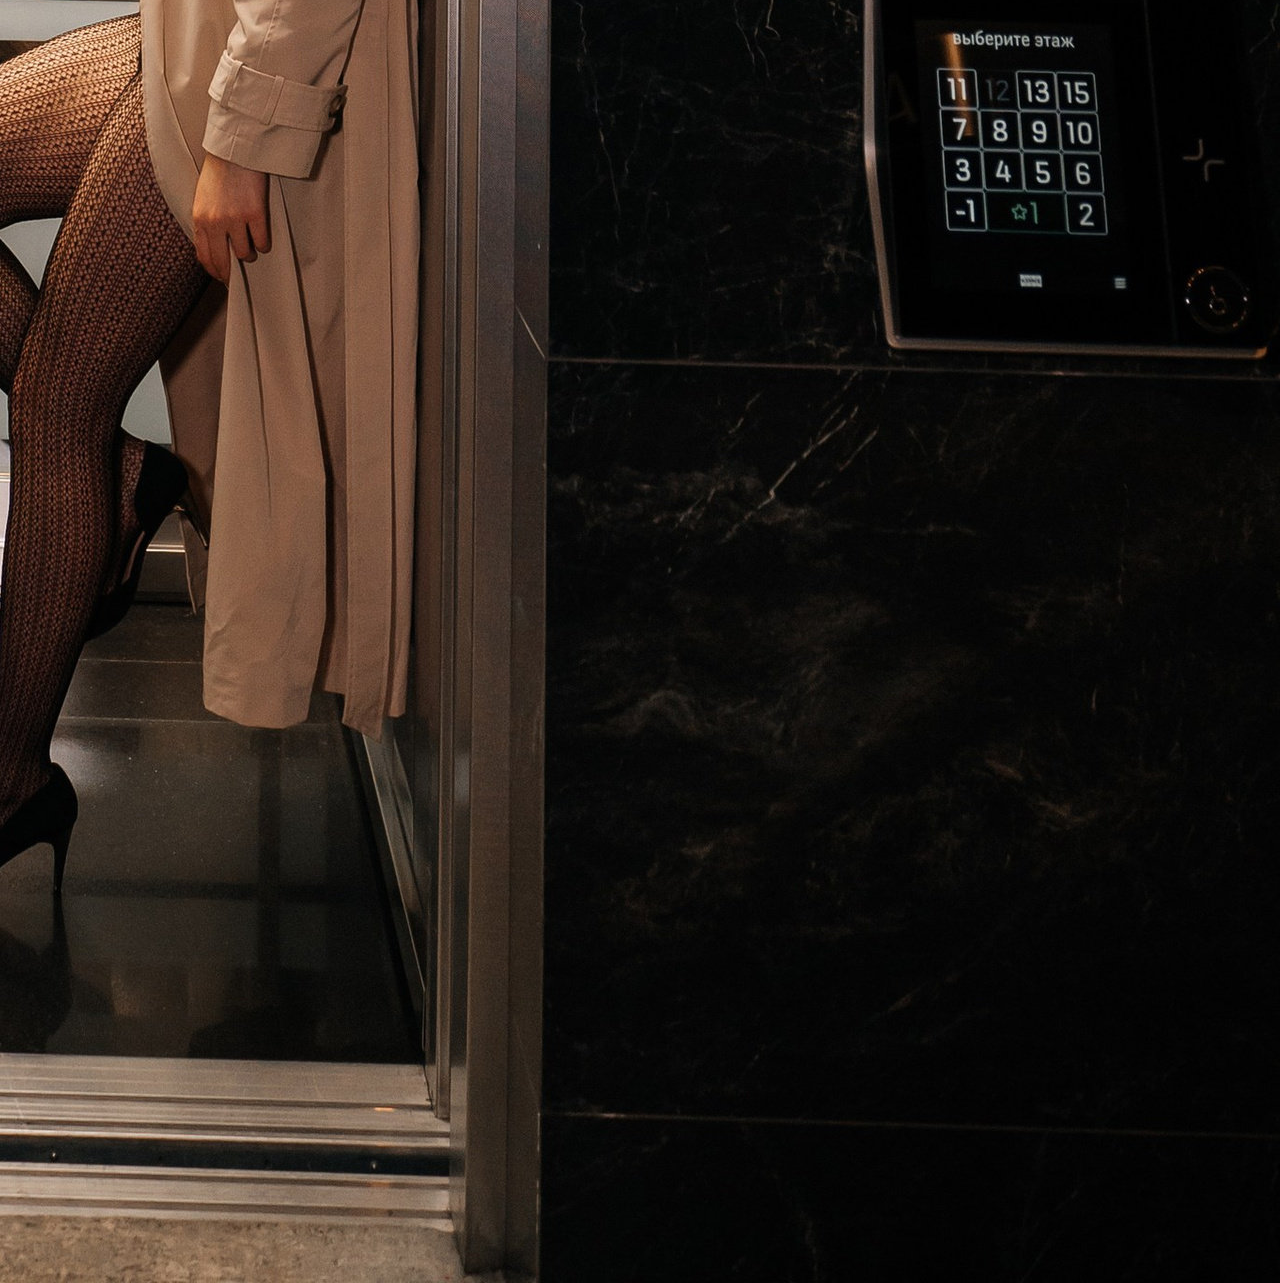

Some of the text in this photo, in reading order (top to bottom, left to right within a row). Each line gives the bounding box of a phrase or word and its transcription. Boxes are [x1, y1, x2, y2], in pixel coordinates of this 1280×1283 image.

[952, 29, 1075, 50] выберите этаж
[947, 77, 968, 101] 11
[985, 79, 1010, 102] 12
[1023, 79, 1050, 103] 13
[1063, 81, 1090, 104] 15
[952, 118, 968, 141] 7
[992, 119, 1009, 142] 8
[1031, 120, 1048, 144] 9
[1065, 121, 1093, 145] 10
[955, 158, 971, 182] 3
[995, 159, 1012, 183] 4
[1035, 160, 1051, 184] 5
[1075, 162, 1091, 185] 6
[955, 199, 976, 223] -1
[1029, 201, 1039, 225] 1
[1079, 202, 1095, 227] 2
